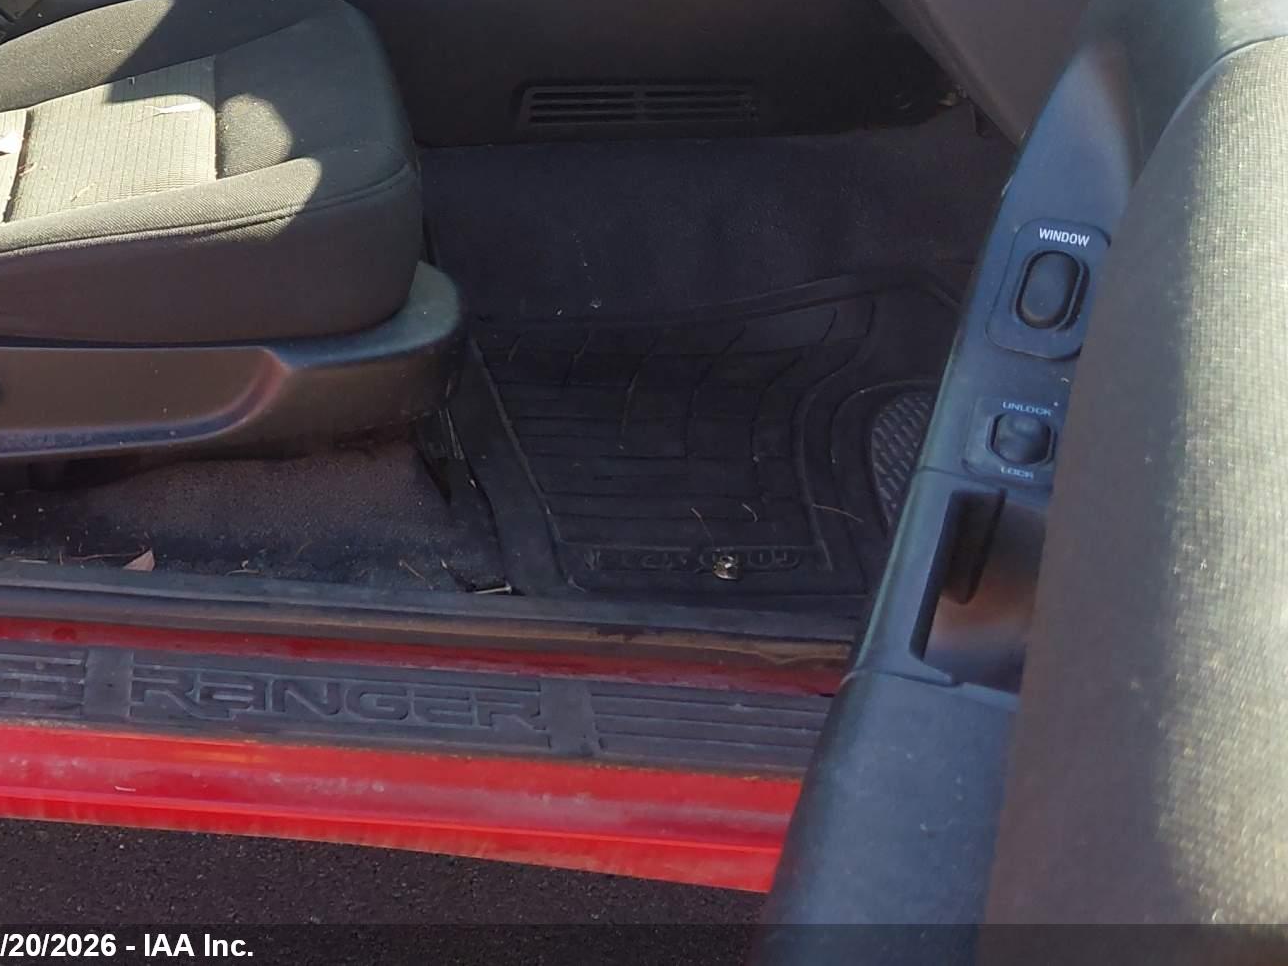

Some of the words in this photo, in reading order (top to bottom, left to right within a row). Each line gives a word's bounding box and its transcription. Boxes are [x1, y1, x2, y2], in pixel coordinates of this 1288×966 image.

[1038, 227, 1090, 248] WINDOW
[1002, 400, 1053, 417] UNLOCK
[1000, 465, 1034, 480] LOCK
[133, 669, 545, 732] RANGER
